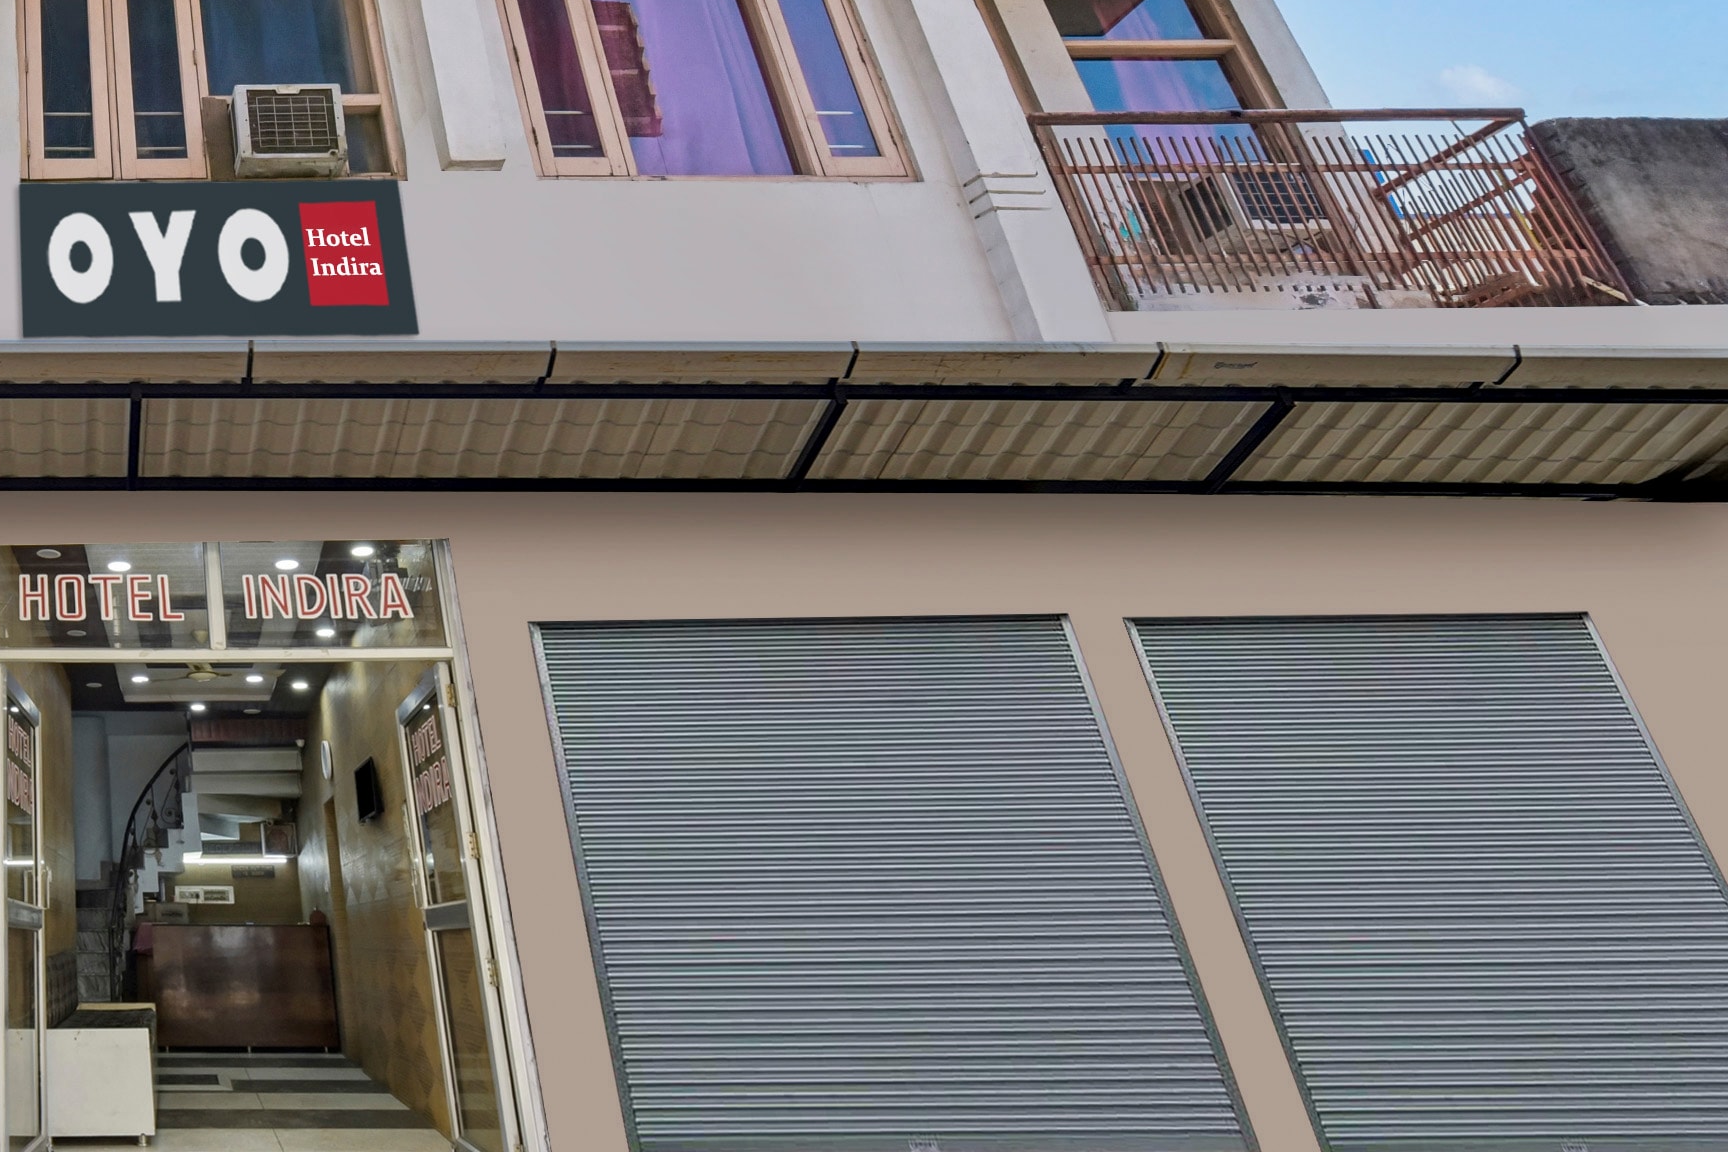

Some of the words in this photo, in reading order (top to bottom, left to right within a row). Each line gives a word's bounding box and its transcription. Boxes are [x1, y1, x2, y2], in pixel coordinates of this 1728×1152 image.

[48, 208, 289, 303] OYO
[305, 226, 372, 248] Hotel
[310, 256, 383, 277] Indira
[19, 574, 185, 621] HOTEL
[241, 573, 415, 619] INDIRA
[412, 715, 442, 766] HOTEL
[414, 756, 453, 816] NDIRA
